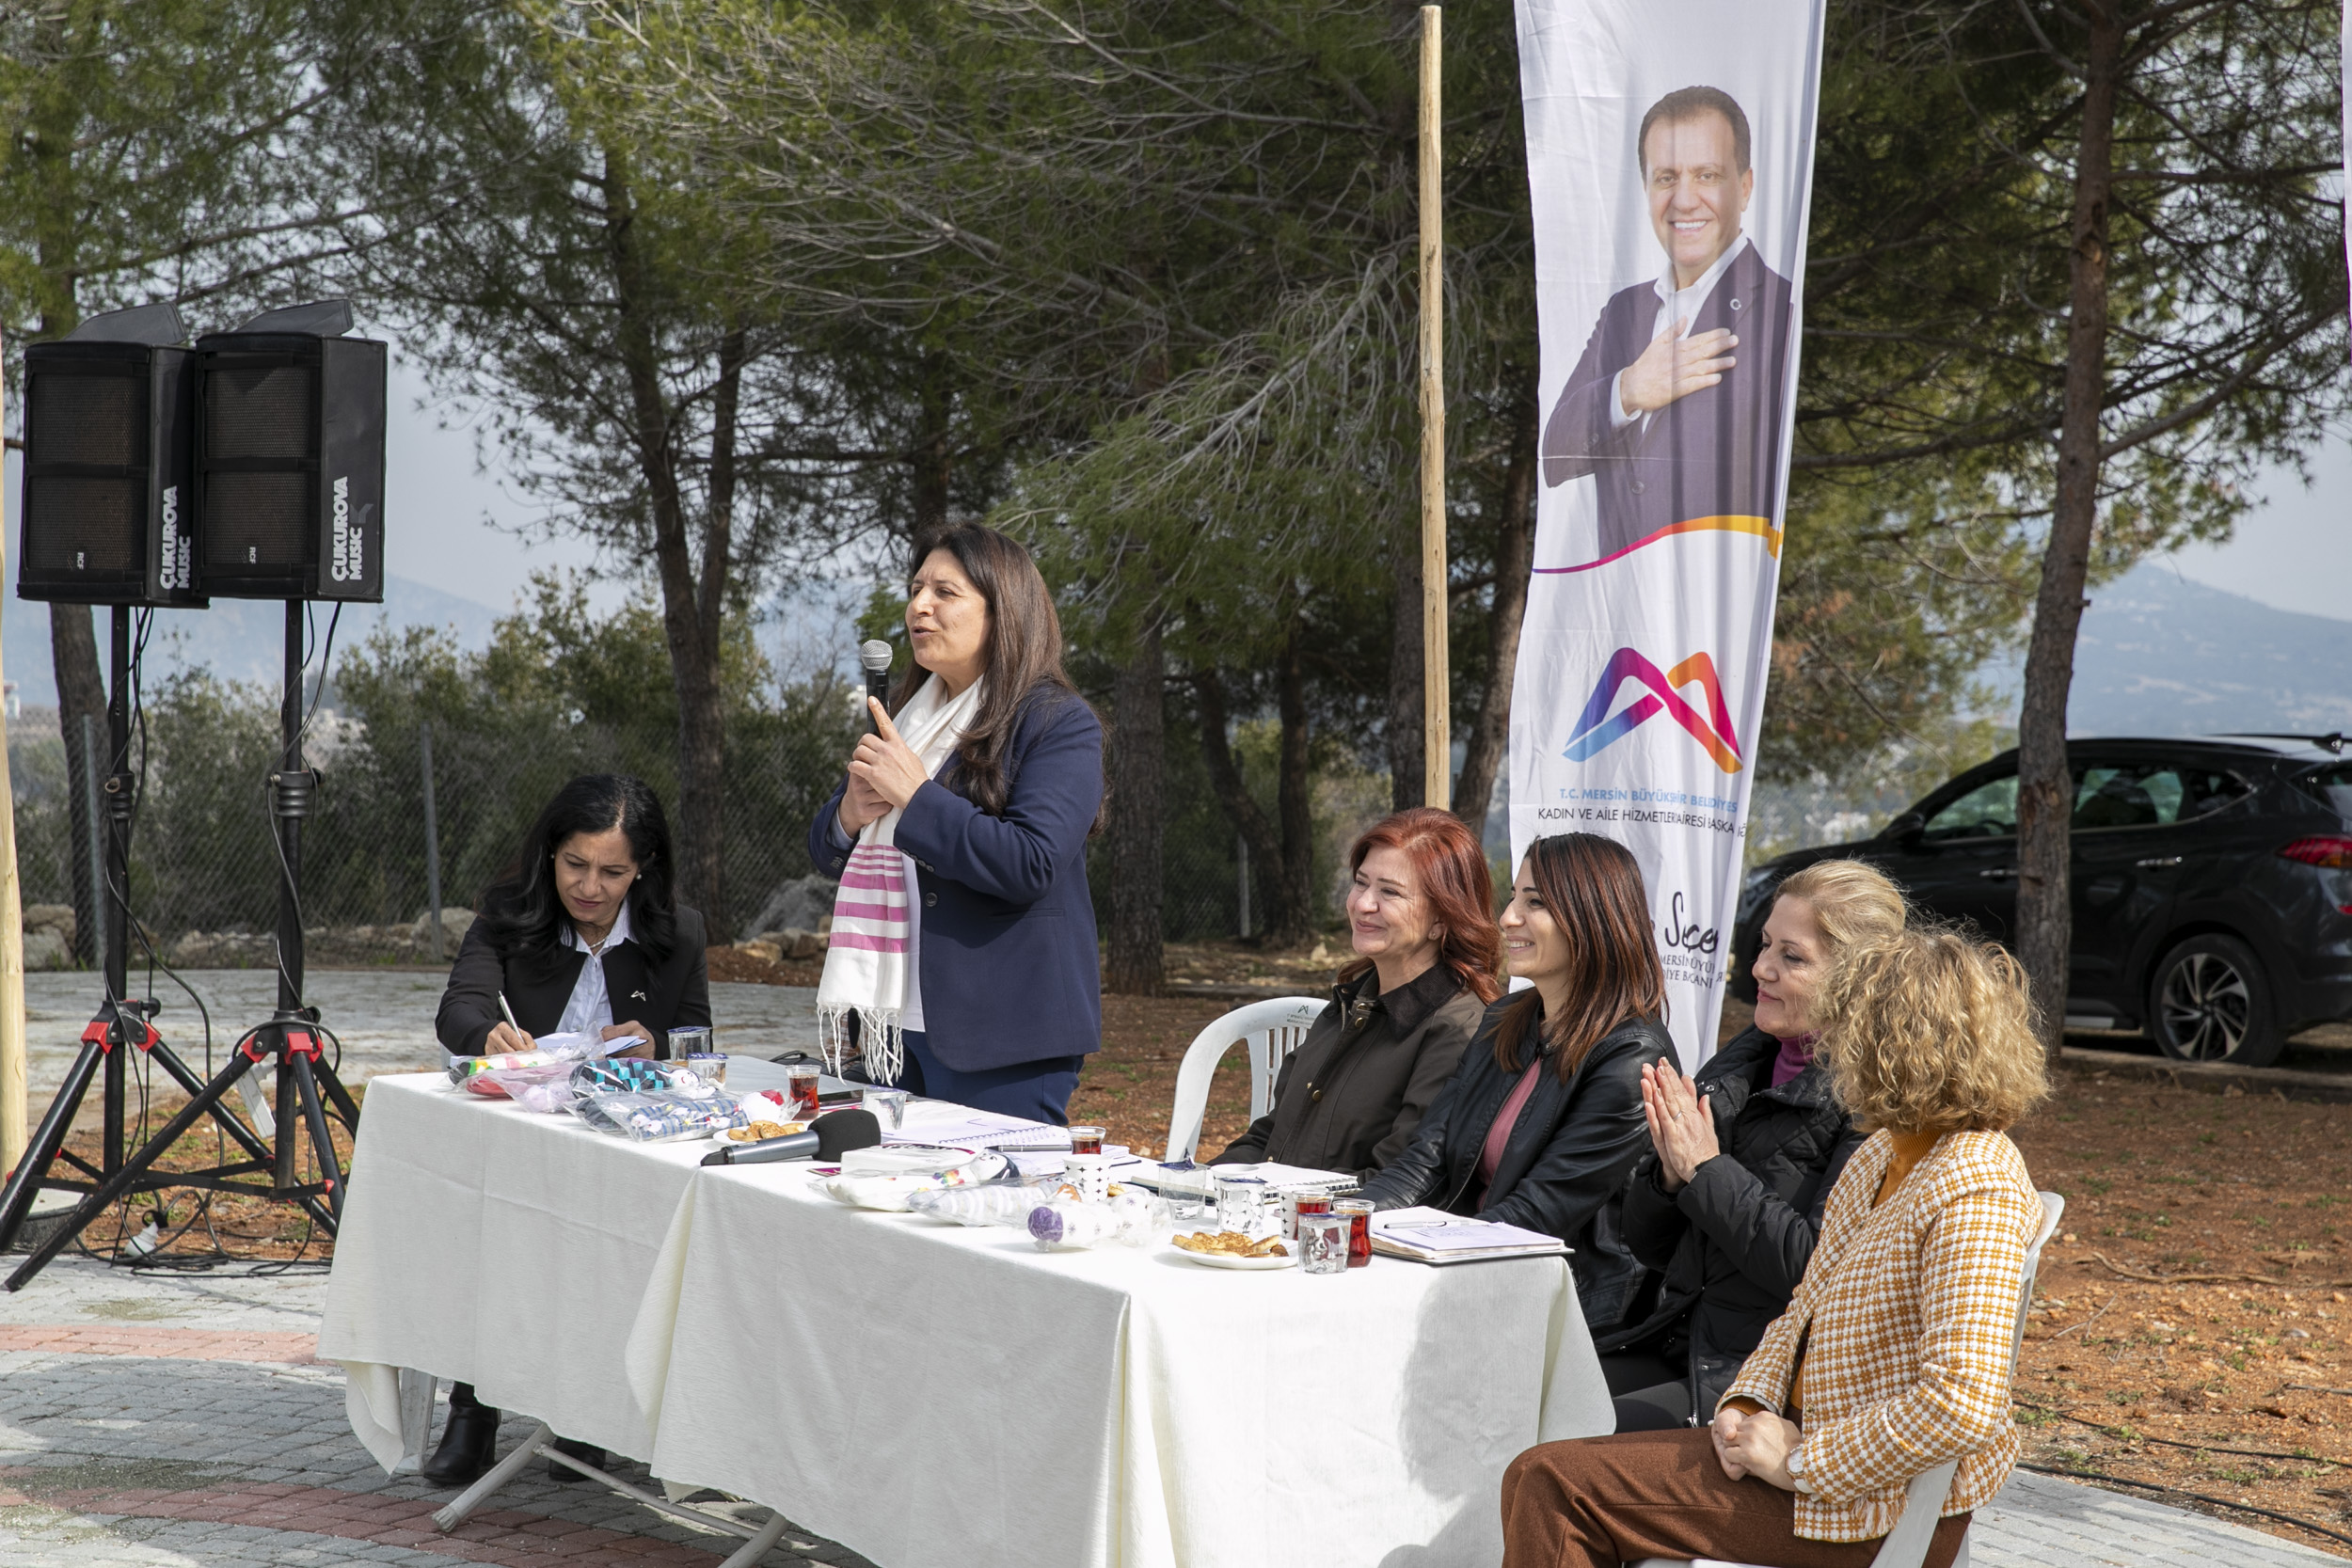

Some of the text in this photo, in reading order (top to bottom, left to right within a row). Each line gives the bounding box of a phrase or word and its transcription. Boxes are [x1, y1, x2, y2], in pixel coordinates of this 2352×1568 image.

[160, 485, 178, 589] ÇUKUROVA
[331, 476, 350, 581] ÇUKUROVA
[349, 526, 362, 580] MUSIC
[177, 535, 191, 589] MUSIC
[1538, 808, 1574, 819] KADIN
[1579, 809, 1592, 820] VE
[1596, 806, 1618, 821] AİLE
[1560, 788, 1579, 800] T.C.
[1582, 787, 1628, 801] MERSİN
